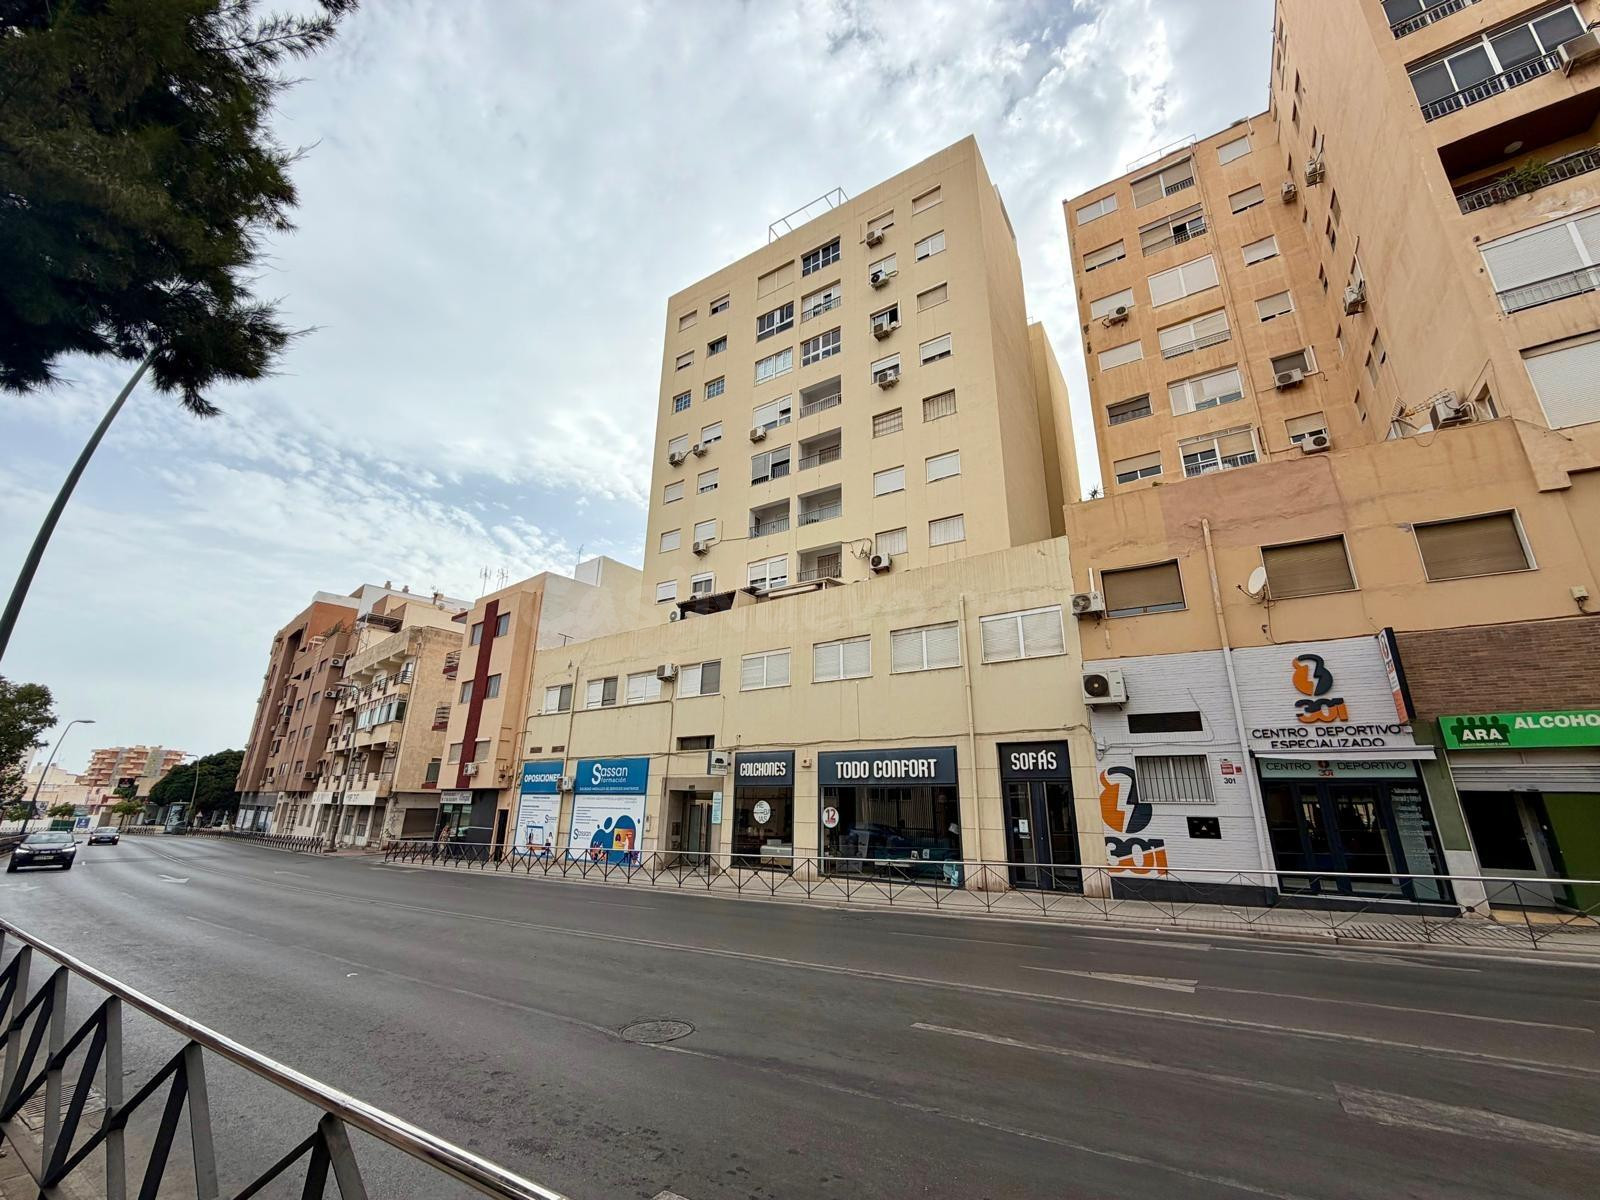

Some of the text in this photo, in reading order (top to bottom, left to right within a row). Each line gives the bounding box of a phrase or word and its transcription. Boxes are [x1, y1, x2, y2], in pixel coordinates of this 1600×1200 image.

[1295, 697, 1349, 723] 301
[1252, 724, 1401, 739] CENTRO DEPORTIVO
[1462, 728, 1503, 741] ARA
[1271, 737, 1385, 749] ESPECIALIZADO
[1011, 749, 1057, 770] SOFÁS
[1266, 761, 1407, 771] CENTRO DEPORTIVO
[591, 763, 629, 785] Sassan
[740, 761, 787, 777] COLCHONES
[835, 758, 938, 779] TODO CONFORT
[600, 776, 627, 784] formación
[1223, 777, 1237, 785] 301
[825, 808, 836, 820] 12
